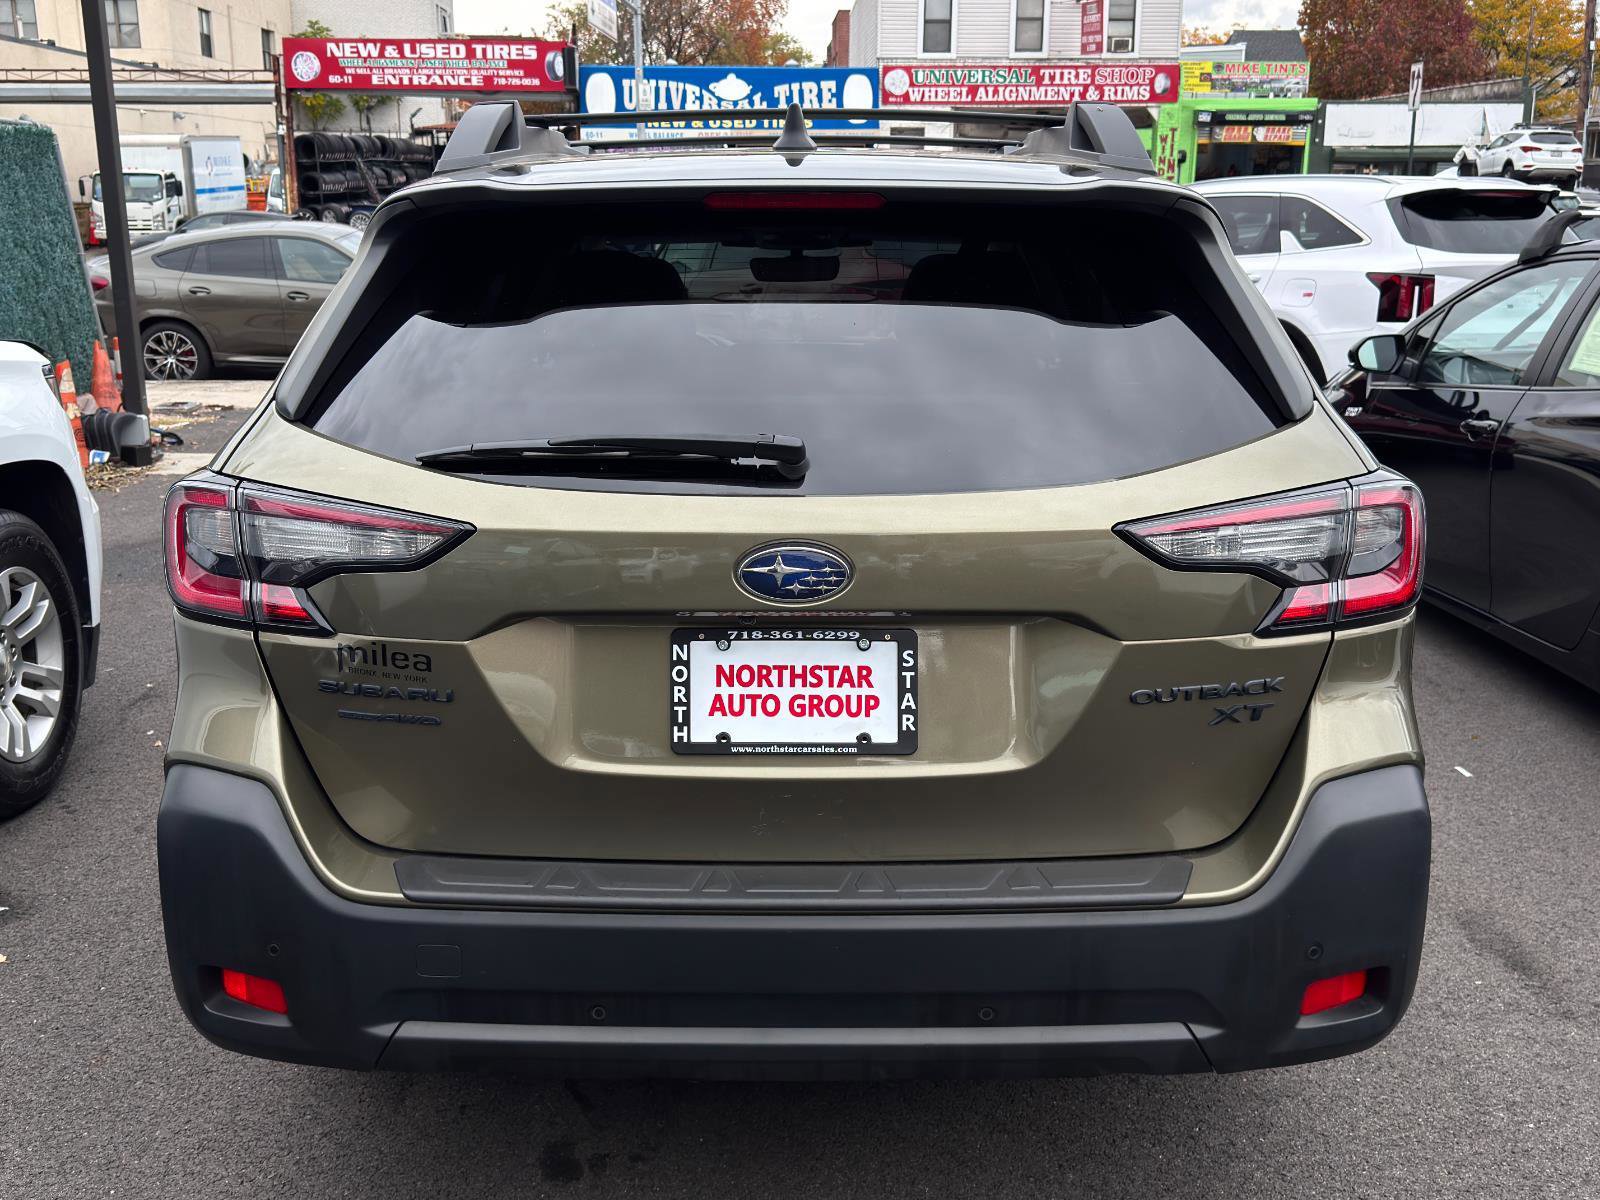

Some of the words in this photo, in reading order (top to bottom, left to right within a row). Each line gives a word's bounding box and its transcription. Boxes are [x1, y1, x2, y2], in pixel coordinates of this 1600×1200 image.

[326, 42, 381, 58] NEW
[384, 45, 401, 58] &
[403, 43, 466, 59] USED
[471, 44, 538, 60] TIRES
[338, 58, 366, 67] WHEEL
[444, 59, 470, 68] WHEEL
[471, 60, 507, 69] BALANCE
[1225, 63, 1260, 74] MIKE
[1265, 63, 1307, 74] TINTS
[371, 75, 484, 86] ENTRANCE
[913, 68, 1035, 85] UNIVERSAL
[1040, 68, 1092, 84] TIRE
[1095, 67, 1156, 85] SHOP
[773, 80, 837, 109] TIRE
[908, 86, 972, 102] WHEEL
[975, 86, 1083, 102] ALIGNMENT
[1085, 85, 1100, 101] &
[1103, 86, 1151, 101] RIMS
[727, 630, 860, 640] 718-361-6299
[337, 641, 432, 673] milea
[348, 666, 377, 678] BRONX
[382, 671, 400, 680] NEW
[404, 673, 428, 684] YORK
[715, 664, 874, 689] NORTHSTAR
[318, 679, 455, 702] SUBARU
[671, 644, 689, 743] NORTH
[900, 649, 916, 731] STAR
[1129, 676, 1286, 705] OUTBACK
[708, 694, 781, 717] AUTO
[788, 694, 880, 718] GROUP
[1208, 703, 1275, 727] XT
[730, 744, 858, 754] www.northstarcarsales.com
